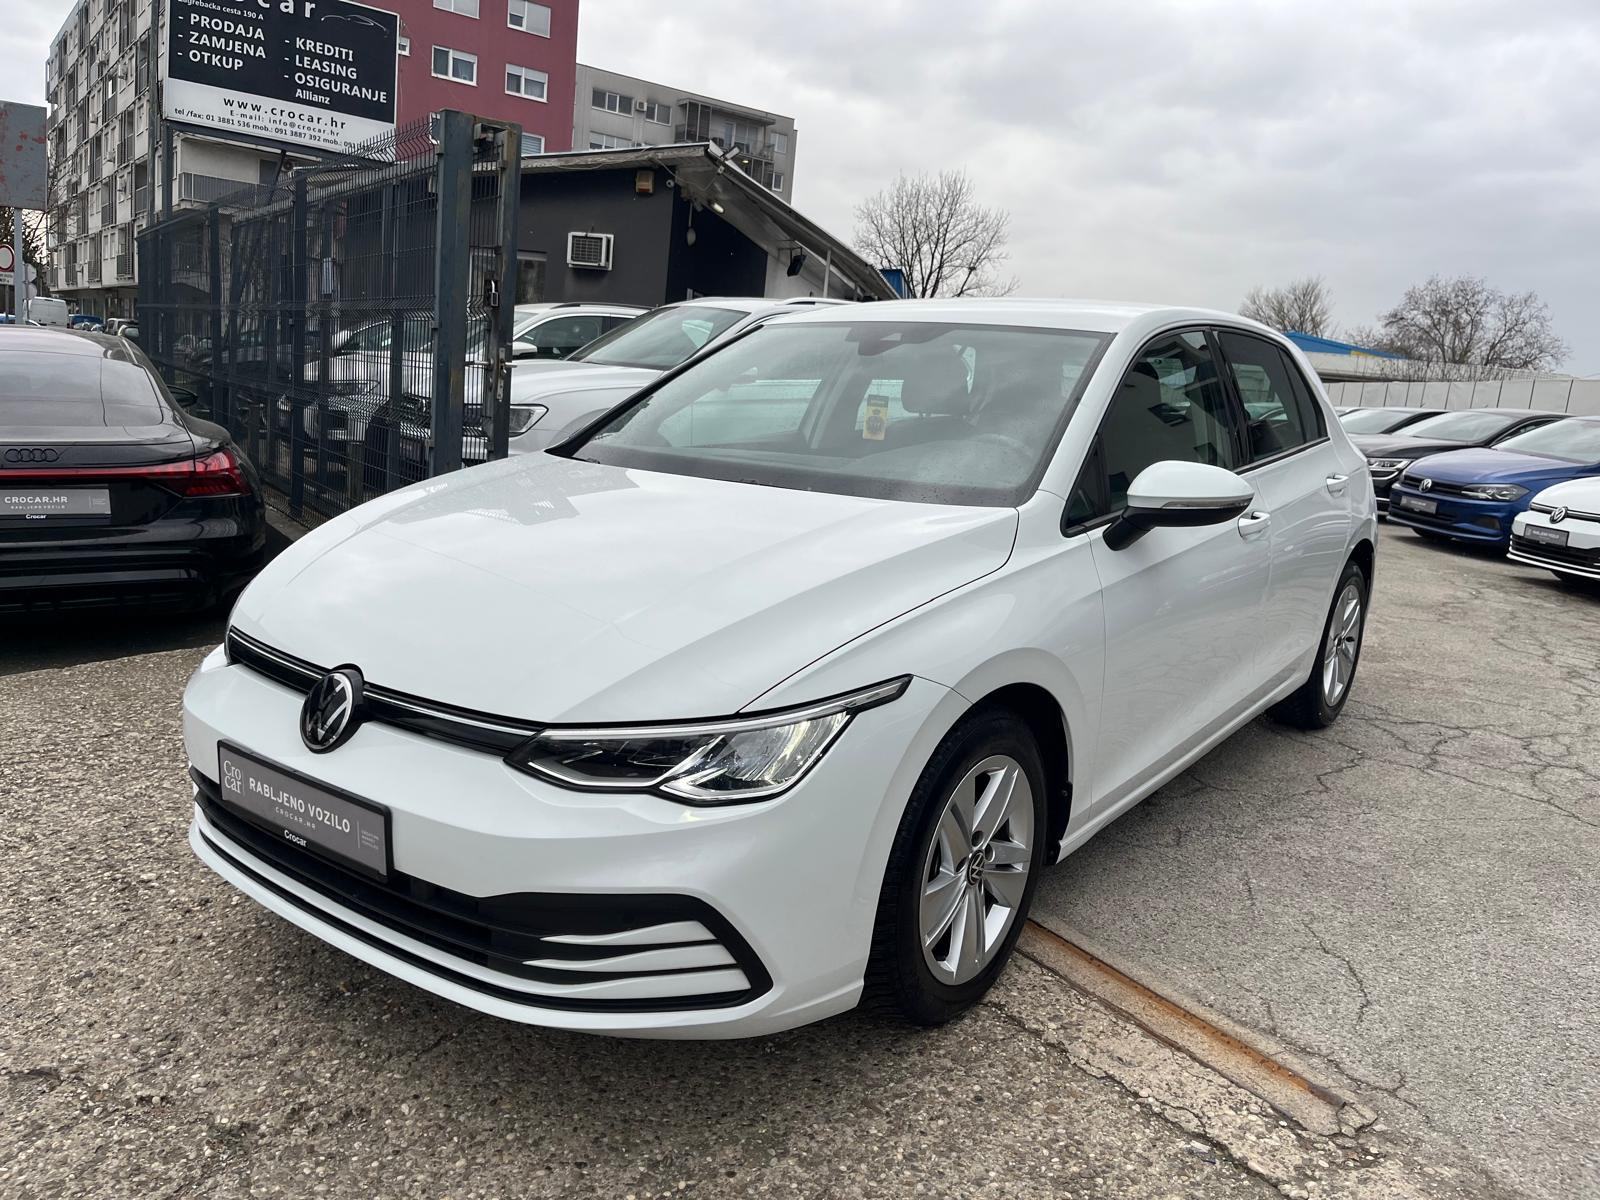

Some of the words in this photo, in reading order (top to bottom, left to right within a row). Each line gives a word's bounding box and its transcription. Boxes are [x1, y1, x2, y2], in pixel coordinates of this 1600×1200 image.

[222, 6, 242, 15] cesta
[243, 10, 257, 19] 190
[190, 13, 265, 41] PRODAJA
[189, 31, 266, 59] ZAMJENA
[296, 37, 354, 61] KREDITI
[189, 49, 244, 71] OTKUP
[295, 54, 357, 80] LEASING
[294, 72, 387, 103] OSIGURANJE
[295, 88, 330, 105] Allianz
[223, 97, 346, 129] www.crocar.hr
[205, 114, 215, 122] 01
[217, 116, 235, 126] 3881
[274, 126, 288, 136] 091
[289, 130, 307, 139] 3887
[308, 133, 321, 142] 392
[268, 117, 340, 137] info@crocar.hr
[4, 496, 69, 504] CROCAR.HR
[223, 760, 242, 780] Cro
[249, 777, 305, 813] RABLJENO
[307, 803, 351, 833] VOZILO
[284, 829, 307, 847] Crocar
